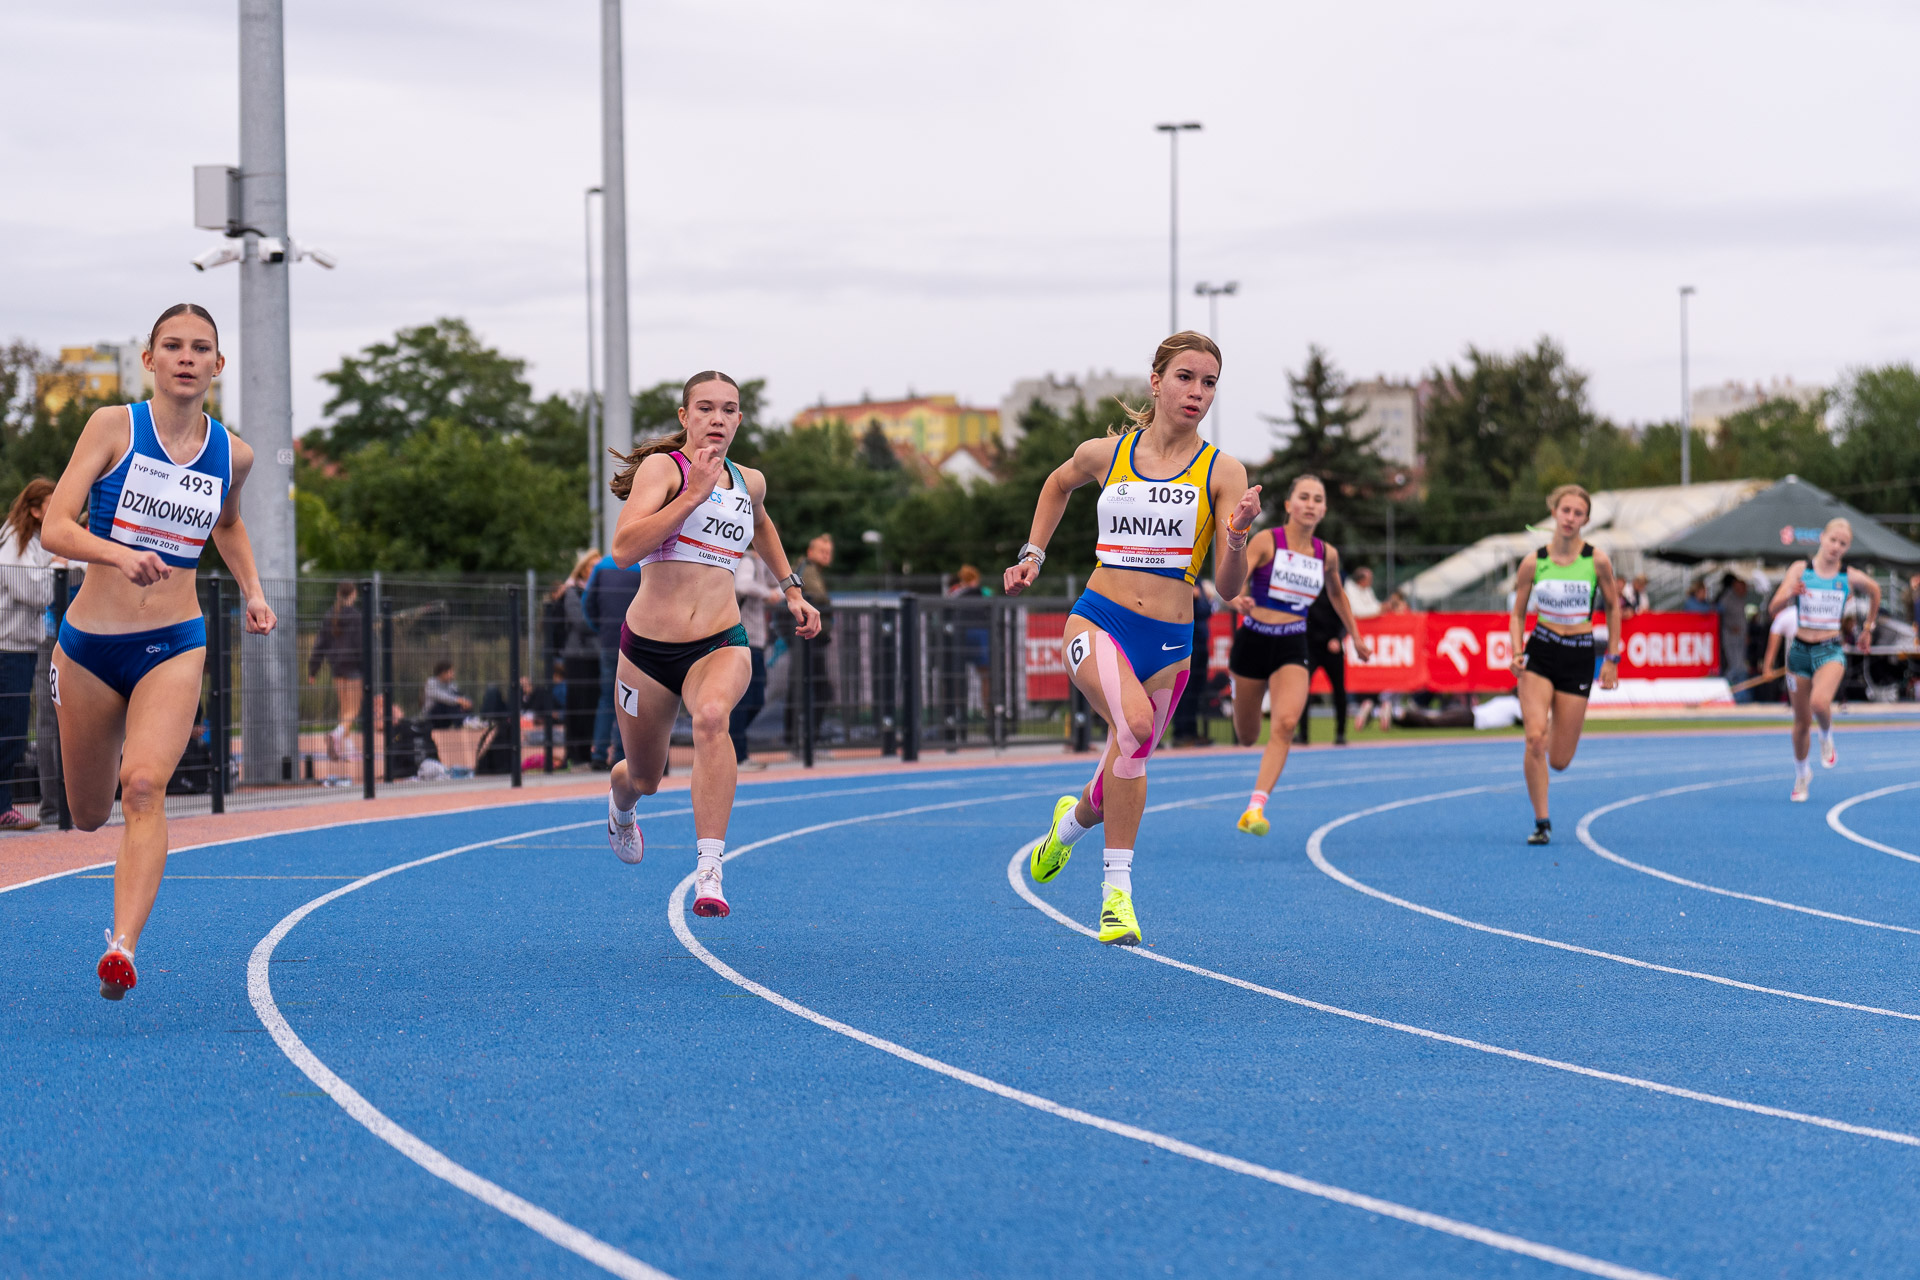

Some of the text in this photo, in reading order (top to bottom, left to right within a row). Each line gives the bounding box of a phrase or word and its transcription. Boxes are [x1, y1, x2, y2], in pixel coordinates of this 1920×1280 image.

[134, 463, 170, 481] TVP SPORT
[179, 474, 213, 496] 493
[1148, 486, 1196, 506] 1039
[121, 489, 213, 530] DZIKOWSKA
[701, 516, 745, 542] ZYGO
[1110, 516, 1184, 537] JANIAK
[135, 535, 158, 547] LUBIN
[159, 540, 180, 552] 2026
[698, 551, 732, 565] LUBIN 2026
[1253, 622, 1282, 635] NIKE
[1071, 638, 1084, 666] 6
[1627, 632, 1714, 668] ORLEN
[50, 668, 57, 699] 8
[621, 683, 633, 710] 7
